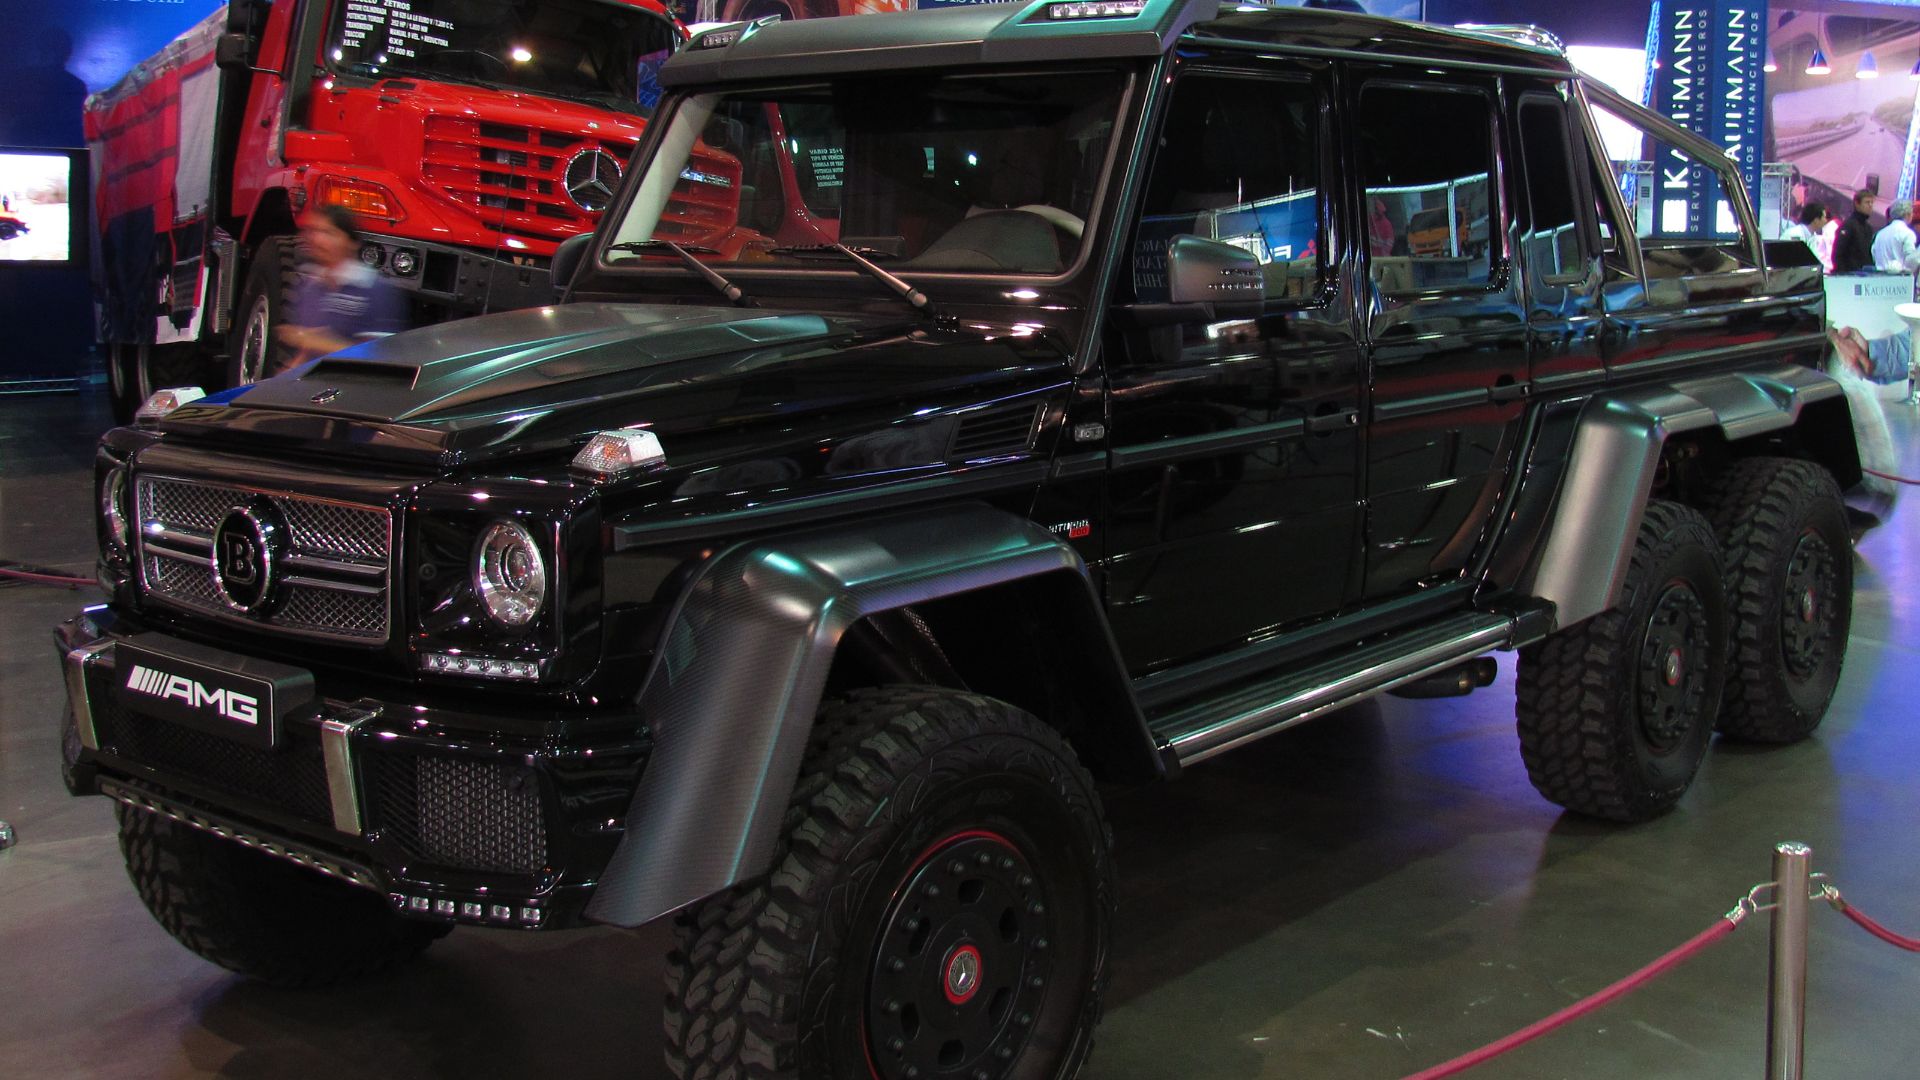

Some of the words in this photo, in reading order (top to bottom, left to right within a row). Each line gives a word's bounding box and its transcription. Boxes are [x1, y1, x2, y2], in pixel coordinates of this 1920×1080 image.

[383, 0, 411, 11] ZETROS
[1663, 10, 1693, 189] KAFMANN
[1694, 9, 1708, 132] FINANCIEROS
[1723, 9, 1746, 162] AUFMANN
[1747, 12, 1759, 134] FINANCIEROS
[1690, 163, 1702, 232] SERVICI
[1745, 146, 1754, 190] ICIOS
[224, 531, 257, 585] B
[163, 674, 258, 725] AMG
